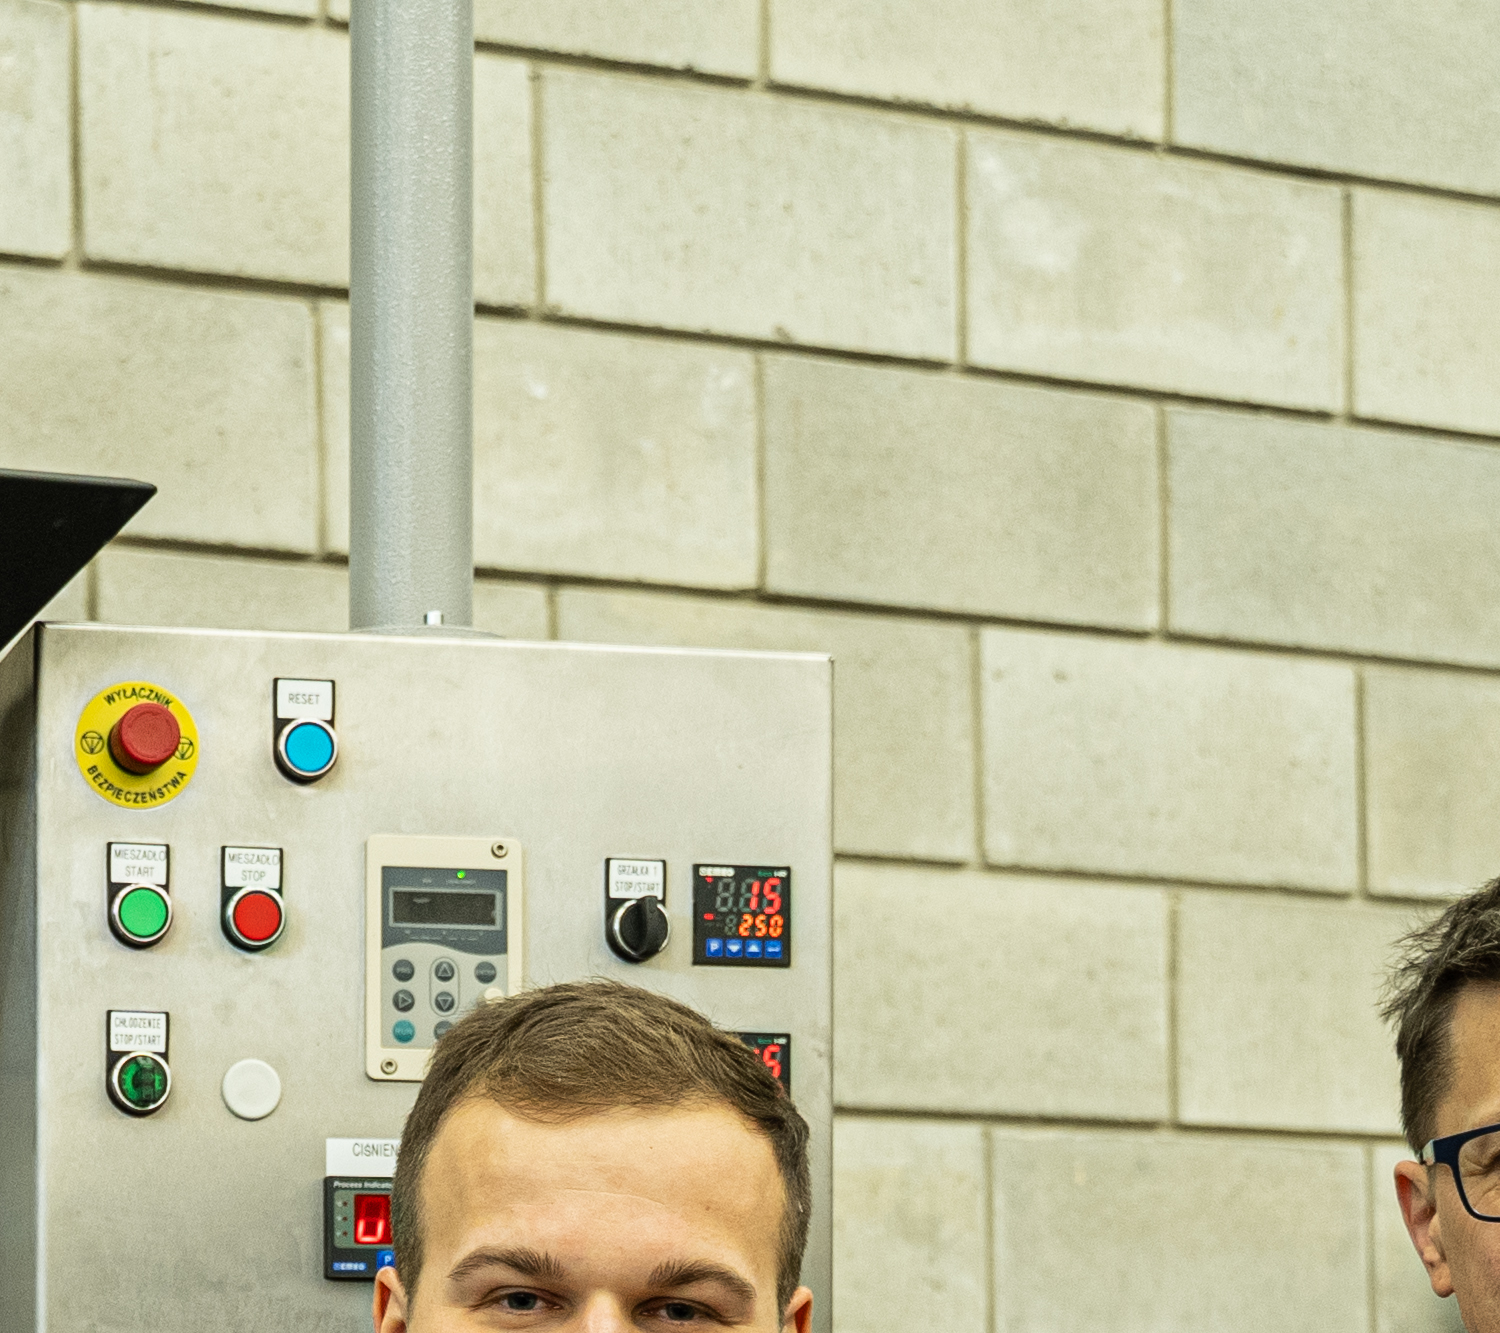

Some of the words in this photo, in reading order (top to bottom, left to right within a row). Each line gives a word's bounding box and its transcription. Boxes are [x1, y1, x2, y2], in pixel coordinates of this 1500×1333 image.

[103, 686, 174, 710] WYŁĄCZNIK
[288, 692, 320, 705] RESET
[87, 764, 188, 804] BEZPIECZEŃSTWA
[114, 848, 167, 862] MIESZADŁO
[228, 853, 281, 866] MIESZADŁO
[125, 866, 155, 877] START
[240, 870, 266, 881] STOP
[614, 881, 660, 893] STOP/START
[749, 877, 783, 915] 15
[738, 913, 784, 938] 250
[710, 942, 718, 951] P
[114, 1016, 161, 1029] CHŁODZENIE
[114, 1034, 161, 1046] STOP/START
[352, 1142, 398, 1157] CIŚNIEN
[333, 1180, 363, 1190] Process
[363, 1182, 394, 1190] Indicato
